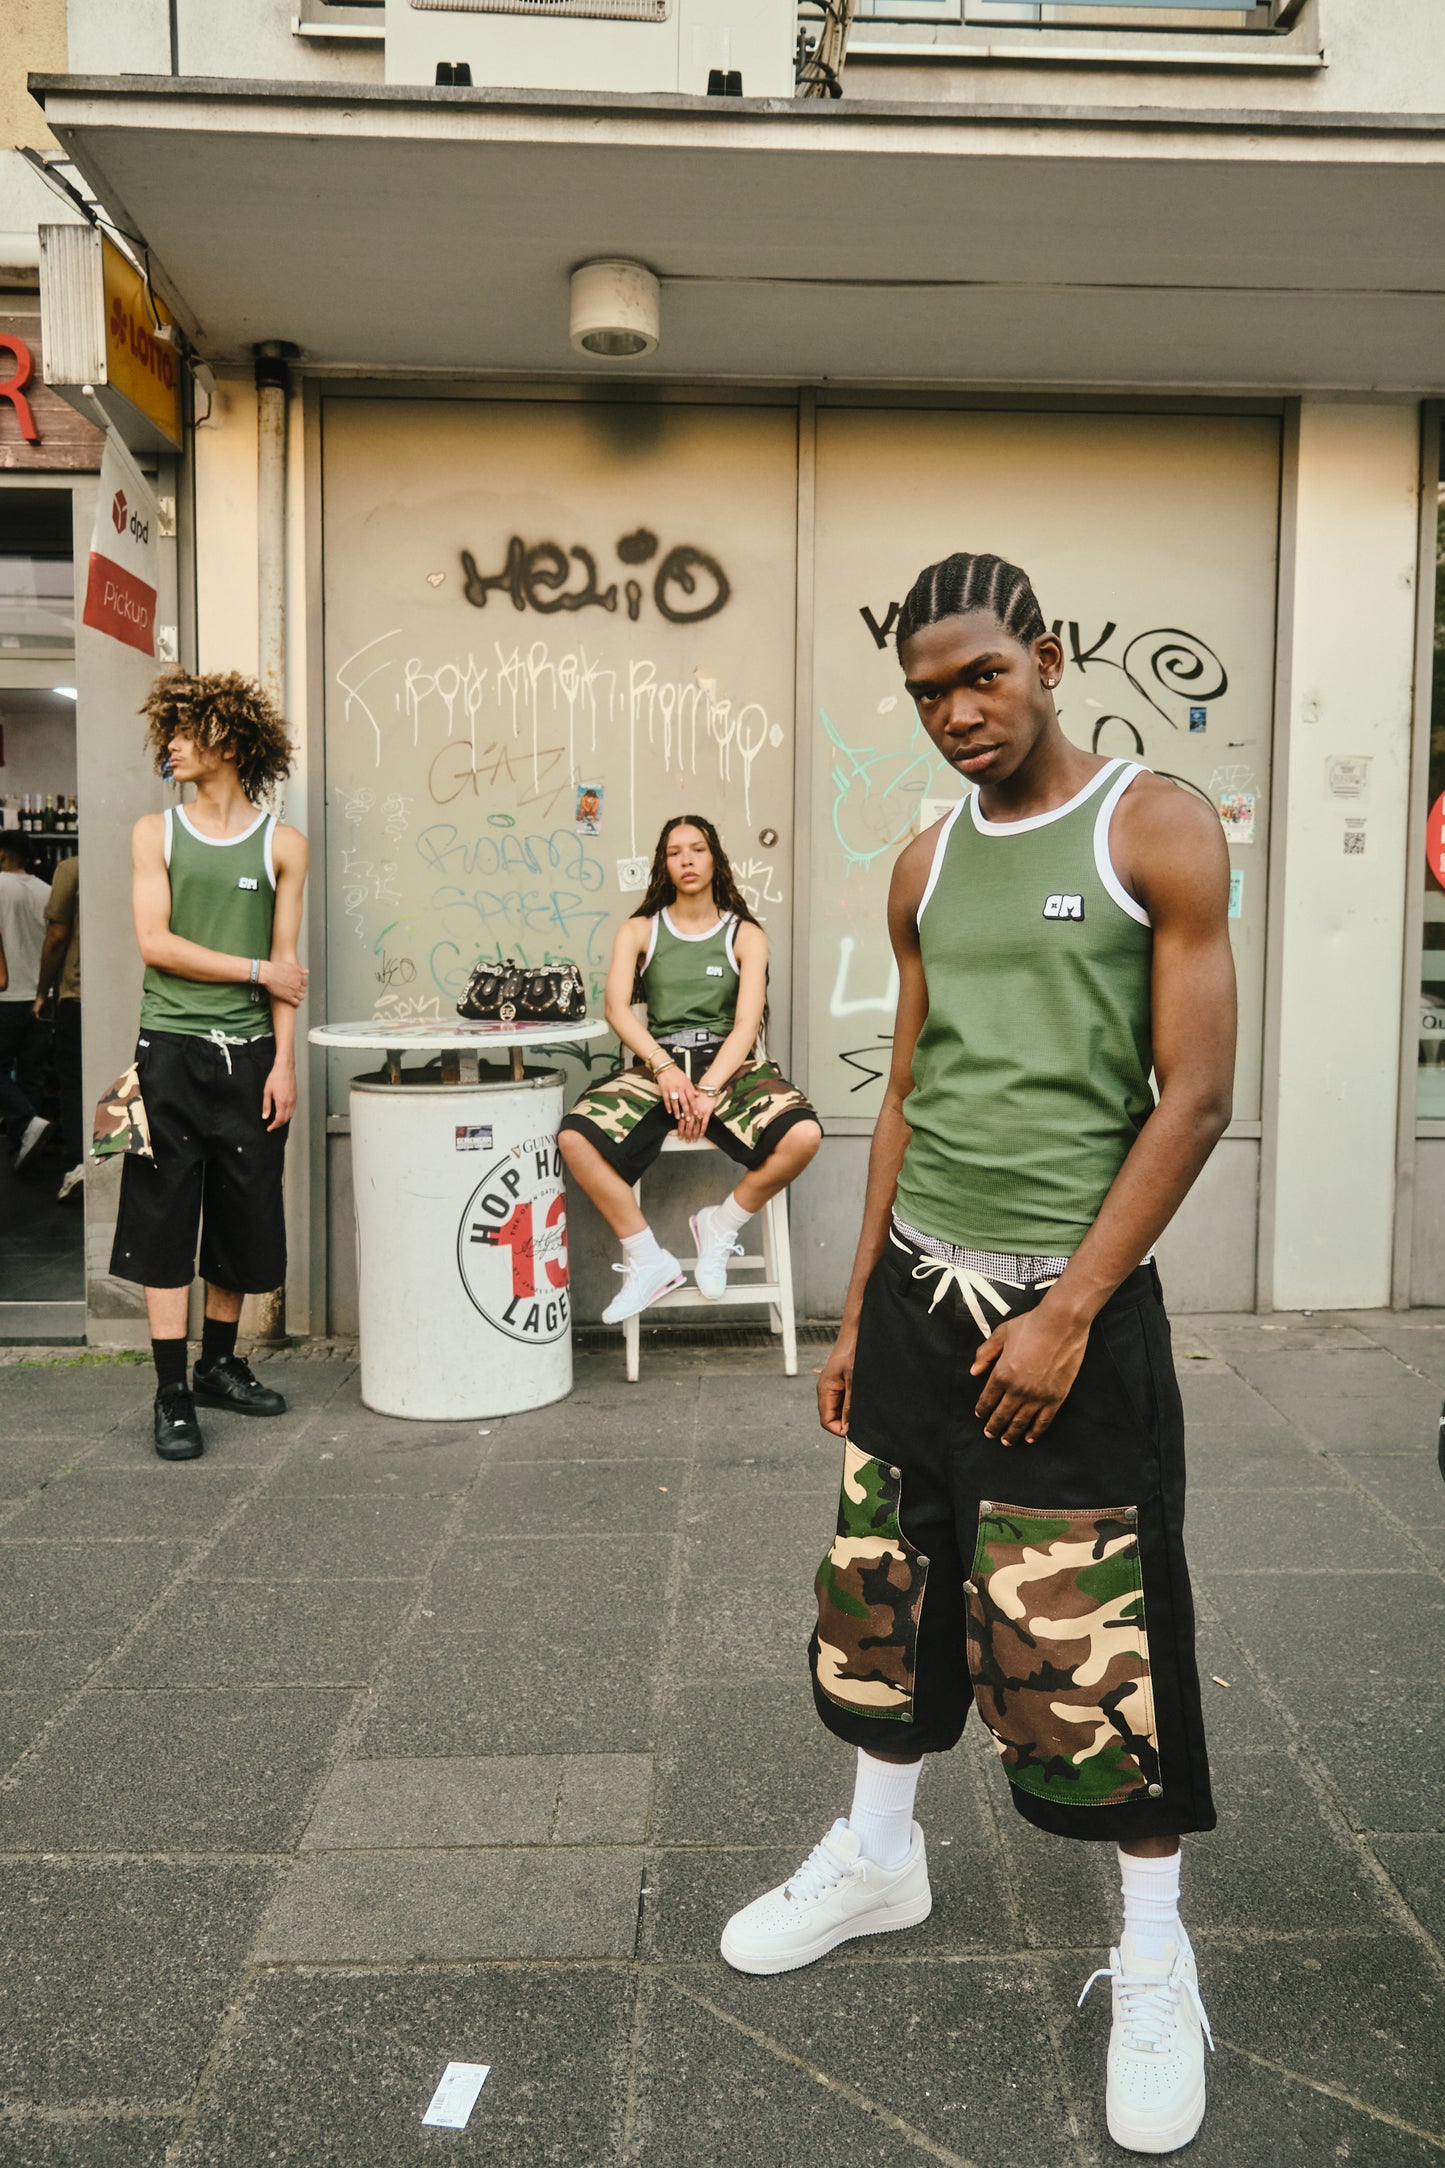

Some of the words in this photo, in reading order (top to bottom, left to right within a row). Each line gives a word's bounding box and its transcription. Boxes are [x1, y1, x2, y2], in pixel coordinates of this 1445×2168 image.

[129, 313, 173, 390] LOTTO
[130, 511, 149, 544] dpd
[103, 580, 149, 631] Pickup
[470, 1168, 521, 1245] HOP
[489, 1191, 569, 1300] 13
